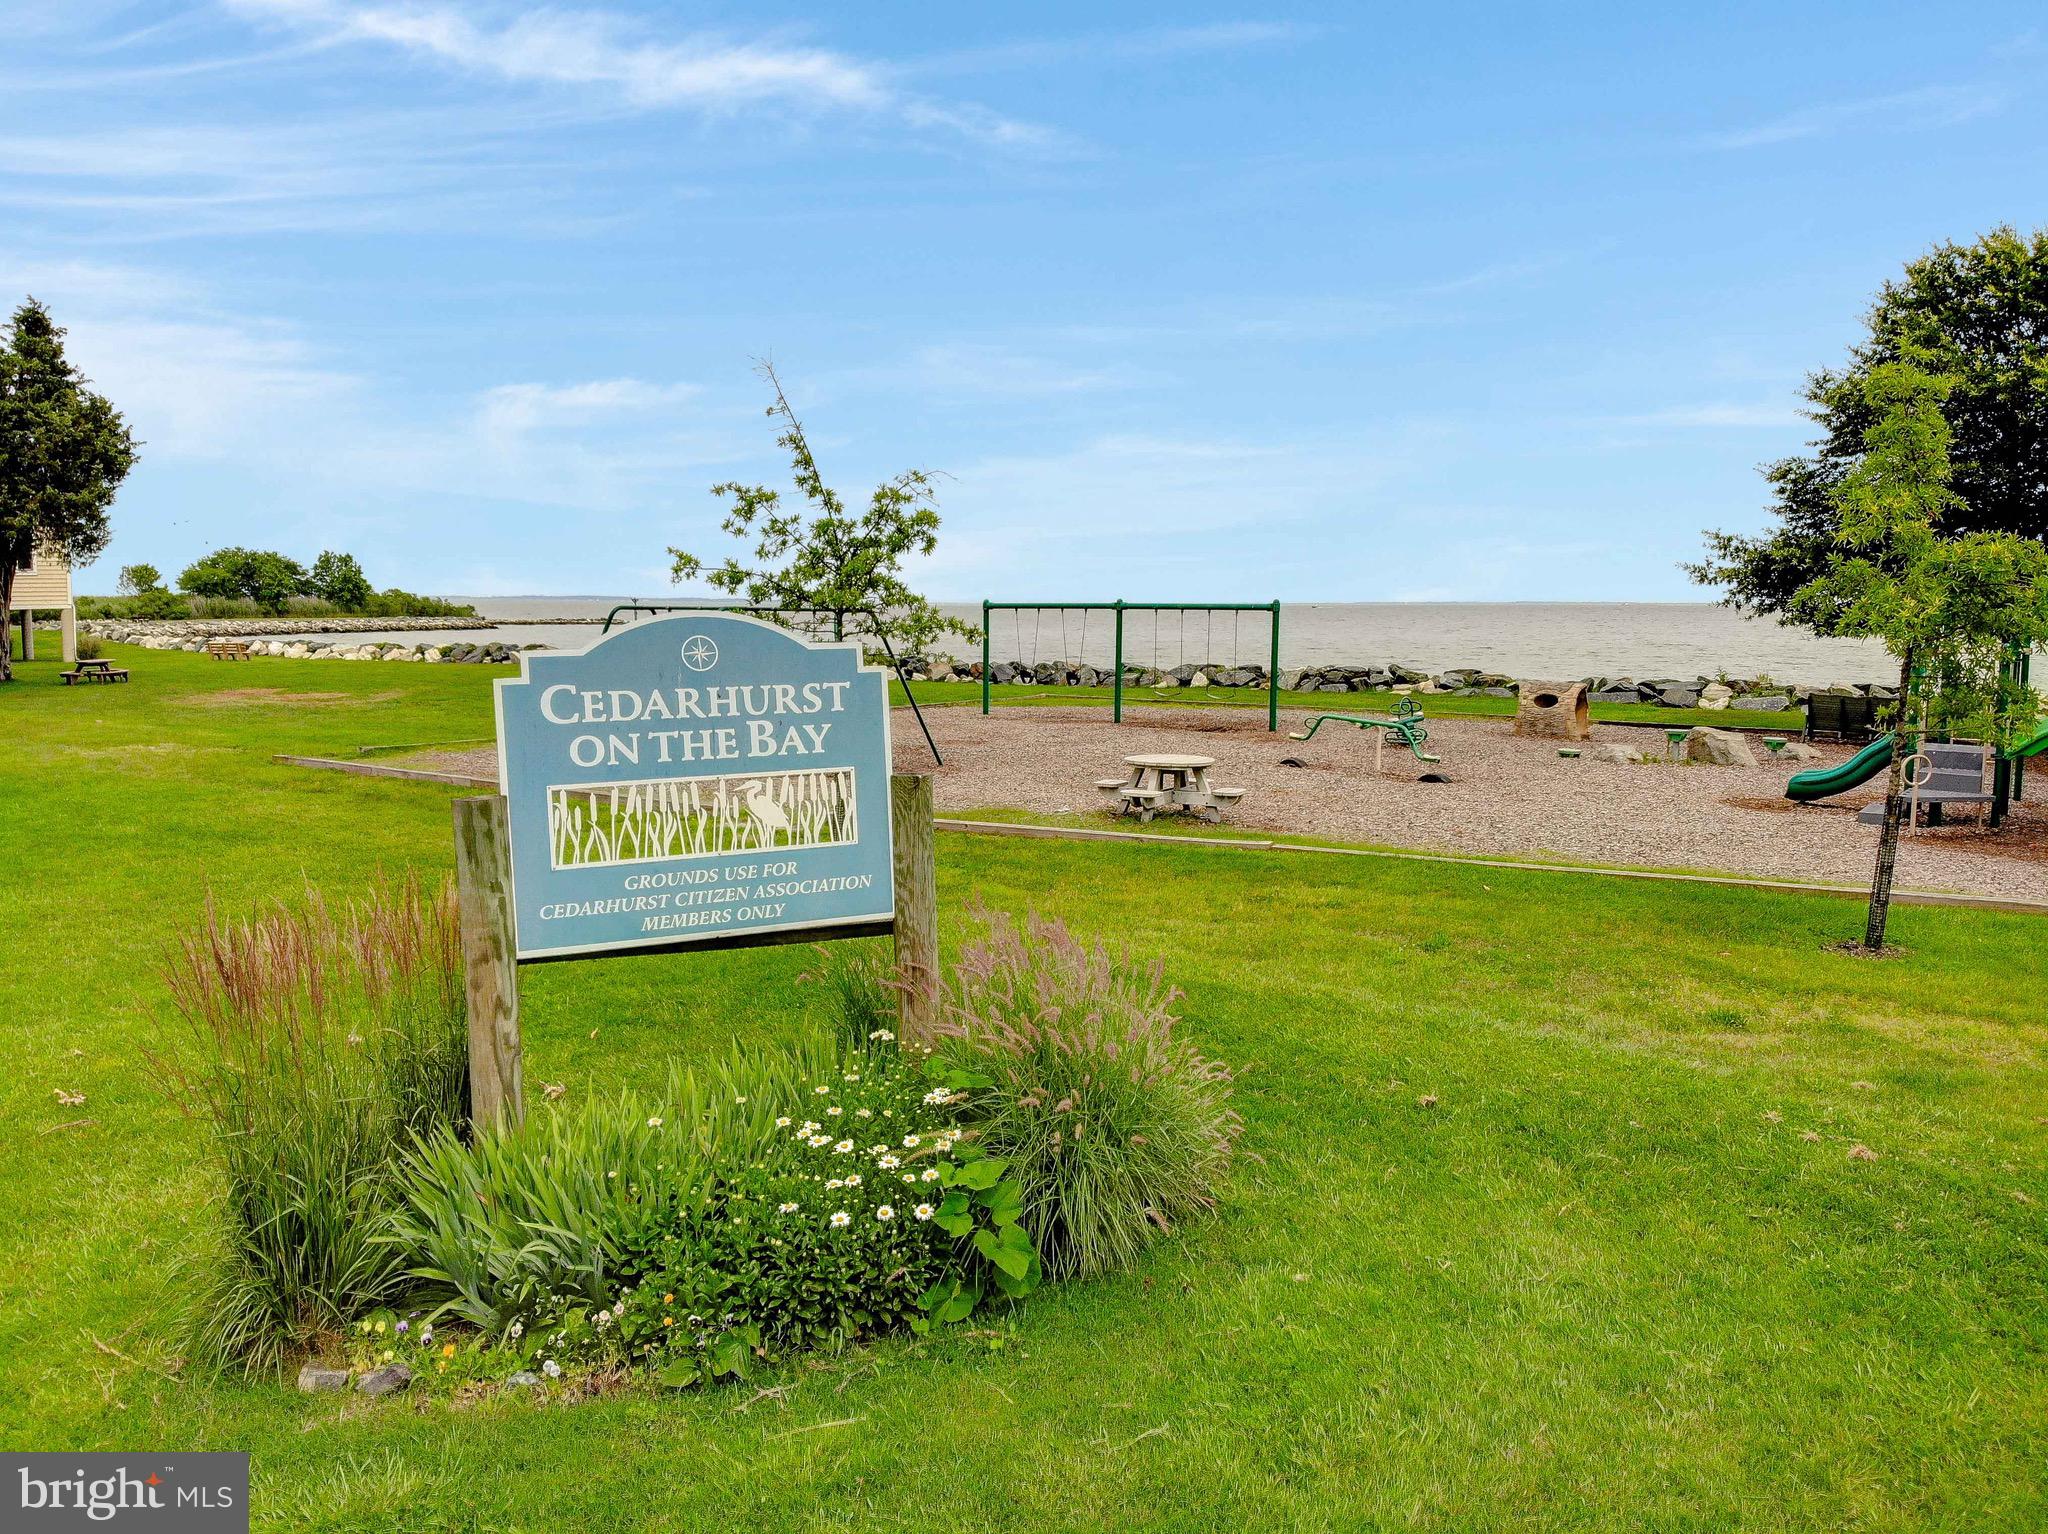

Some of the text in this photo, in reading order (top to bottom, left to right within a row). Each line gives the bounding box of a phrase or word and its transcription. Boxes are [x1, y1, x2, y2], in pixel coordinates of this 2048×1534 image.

[540, 681, 851, 726] CEDARHURST
[569, 719, 832, 768] ON THE BAY
[539, 872, 874, 921] CEDARHURST CITIZEN ASSOCIATION
[624, 861, 799, 892] GROUNDS USE FOR
[640, 901, 787, 933] MEMBERS ONLY
